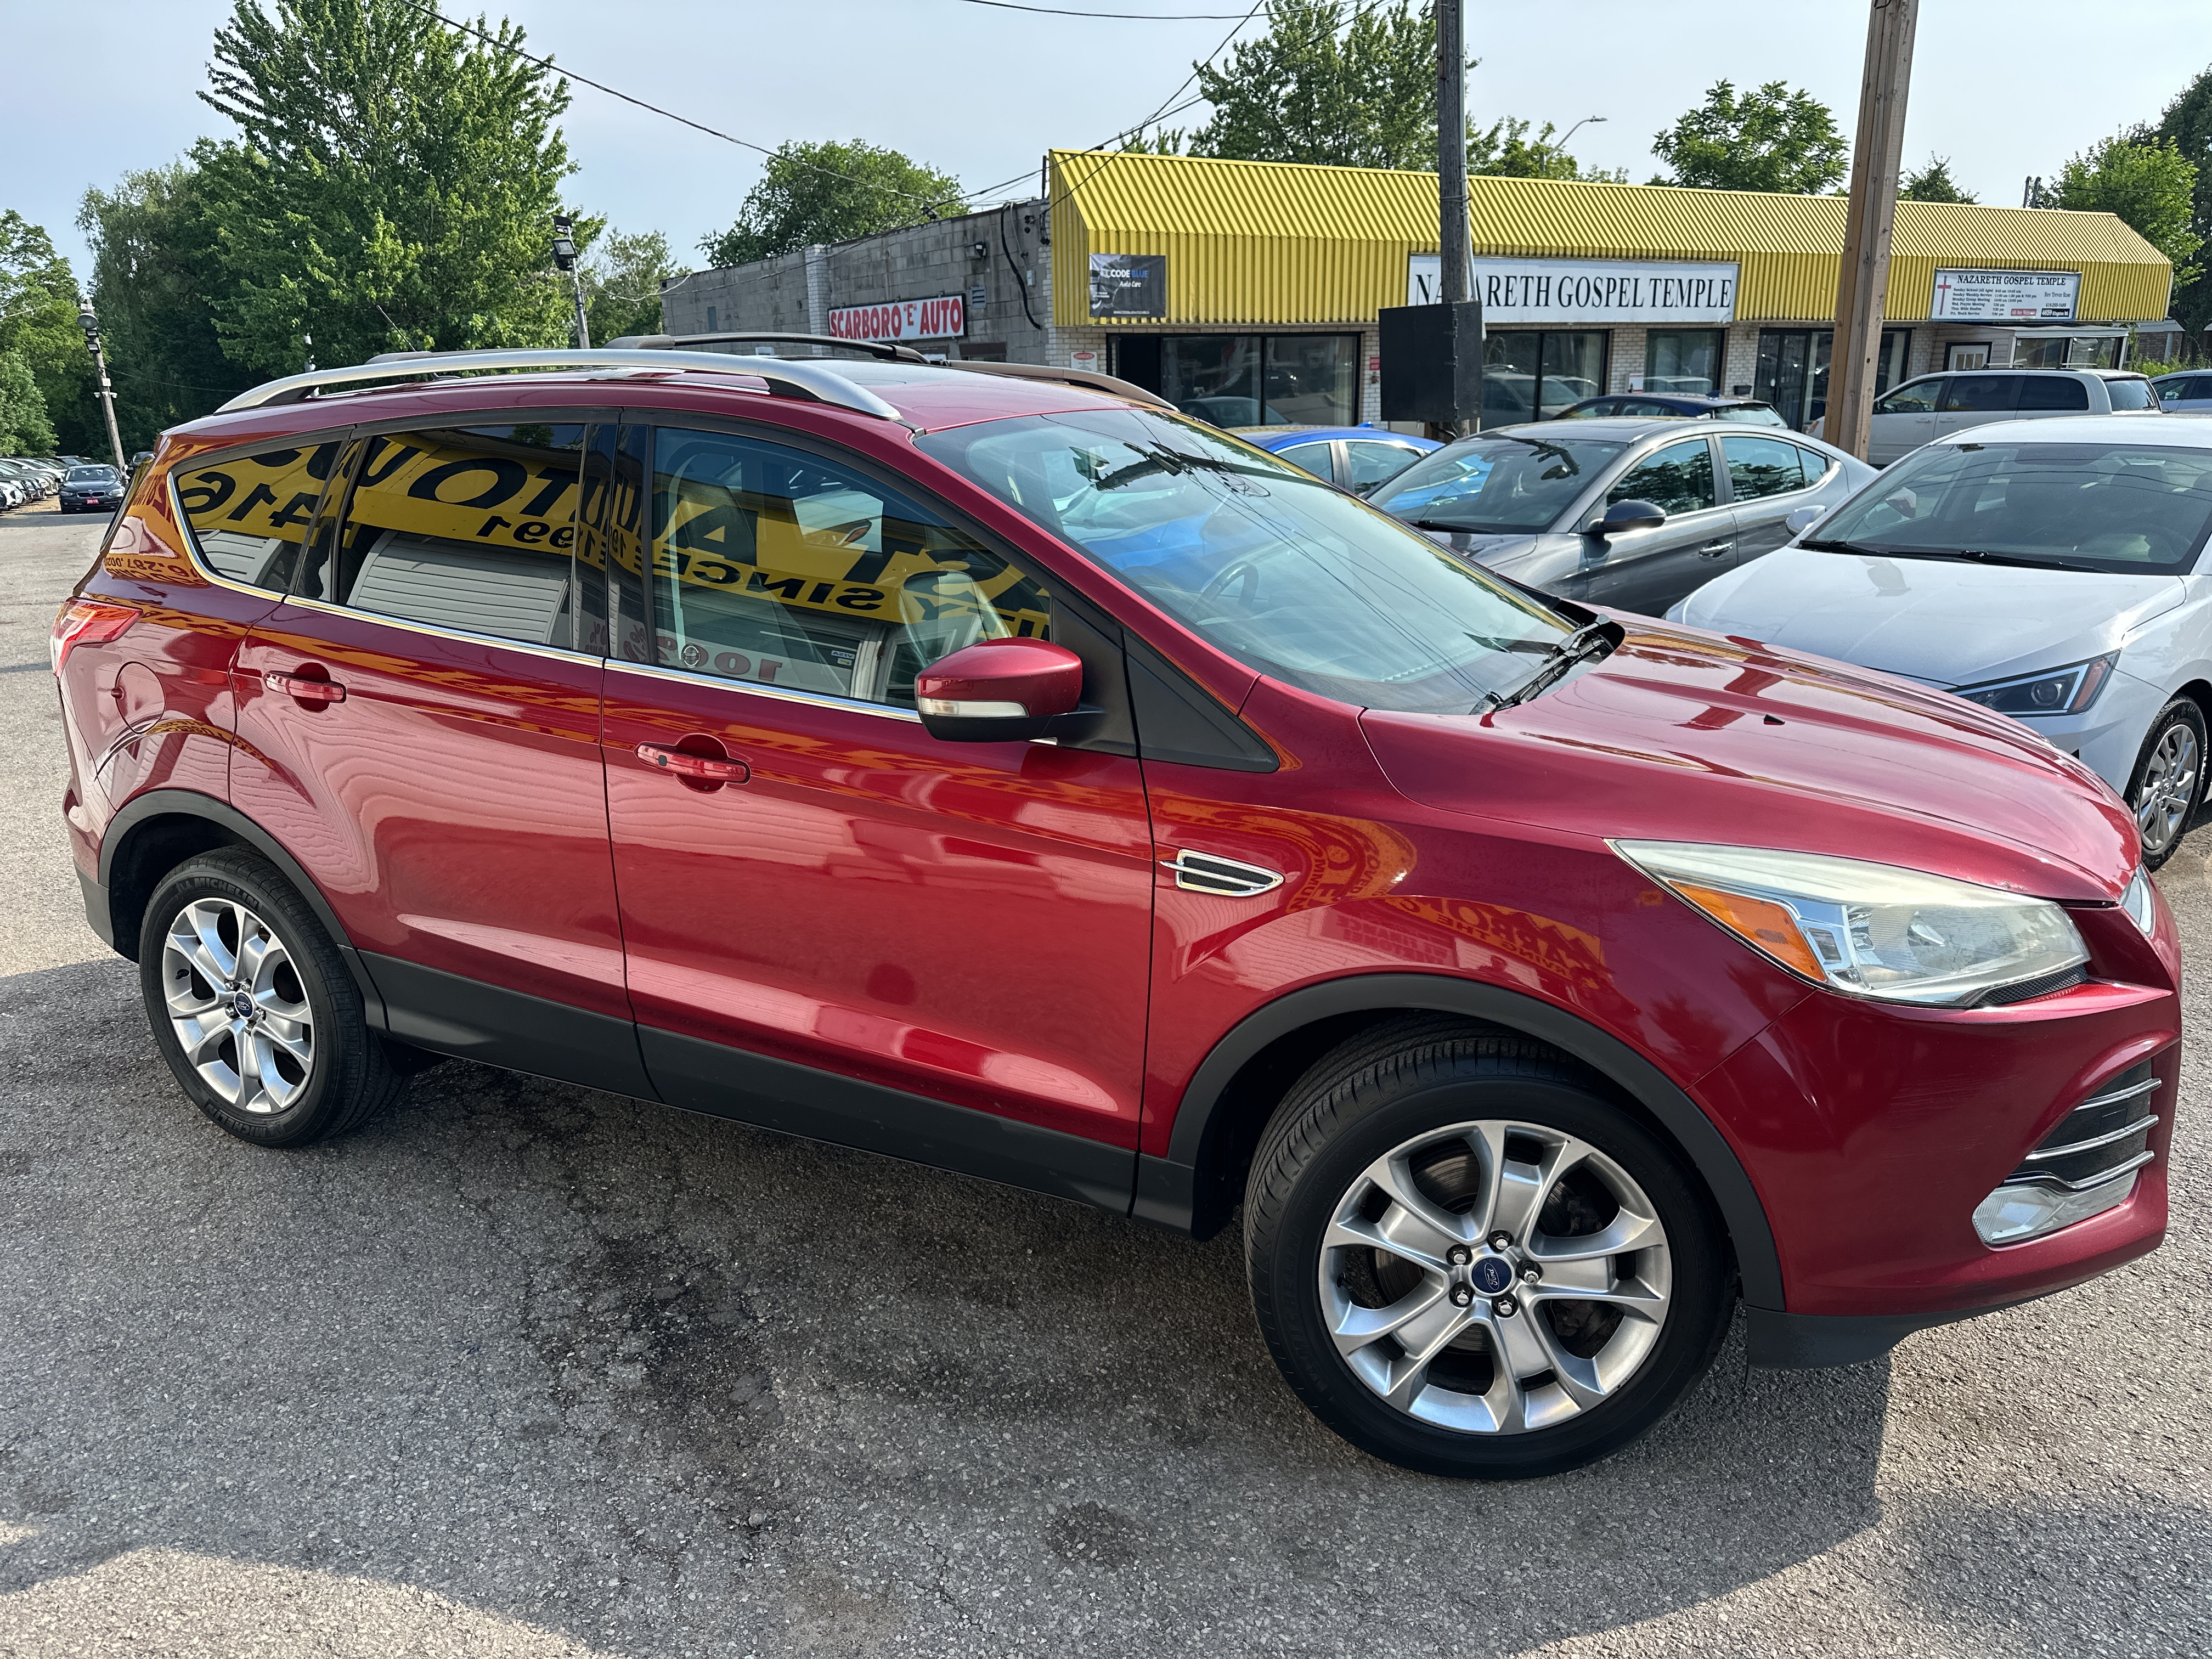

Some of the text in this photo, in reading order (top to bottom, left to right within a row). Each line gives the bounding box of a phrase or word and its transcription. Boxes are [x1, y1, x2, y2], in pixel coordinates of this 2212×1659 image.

[1110, 269, 1148, 278] CODE BLUE
[1957, 275, 2066, 286] NAZARETH GOSPEL TEMPLE
[1558, 276, 1645, 308] GOSPEL
[1649, 278, 1732, 308] TEMPLE
[830, 305, 902, 339] SCARBORO
[919, 298, 962, 335] AUTO
[194, 877, 259, 909] MICHELIN
[204, 1103, 267, 1138] MICHELIN
[1487, 1268, 1498, 1286] Ford
